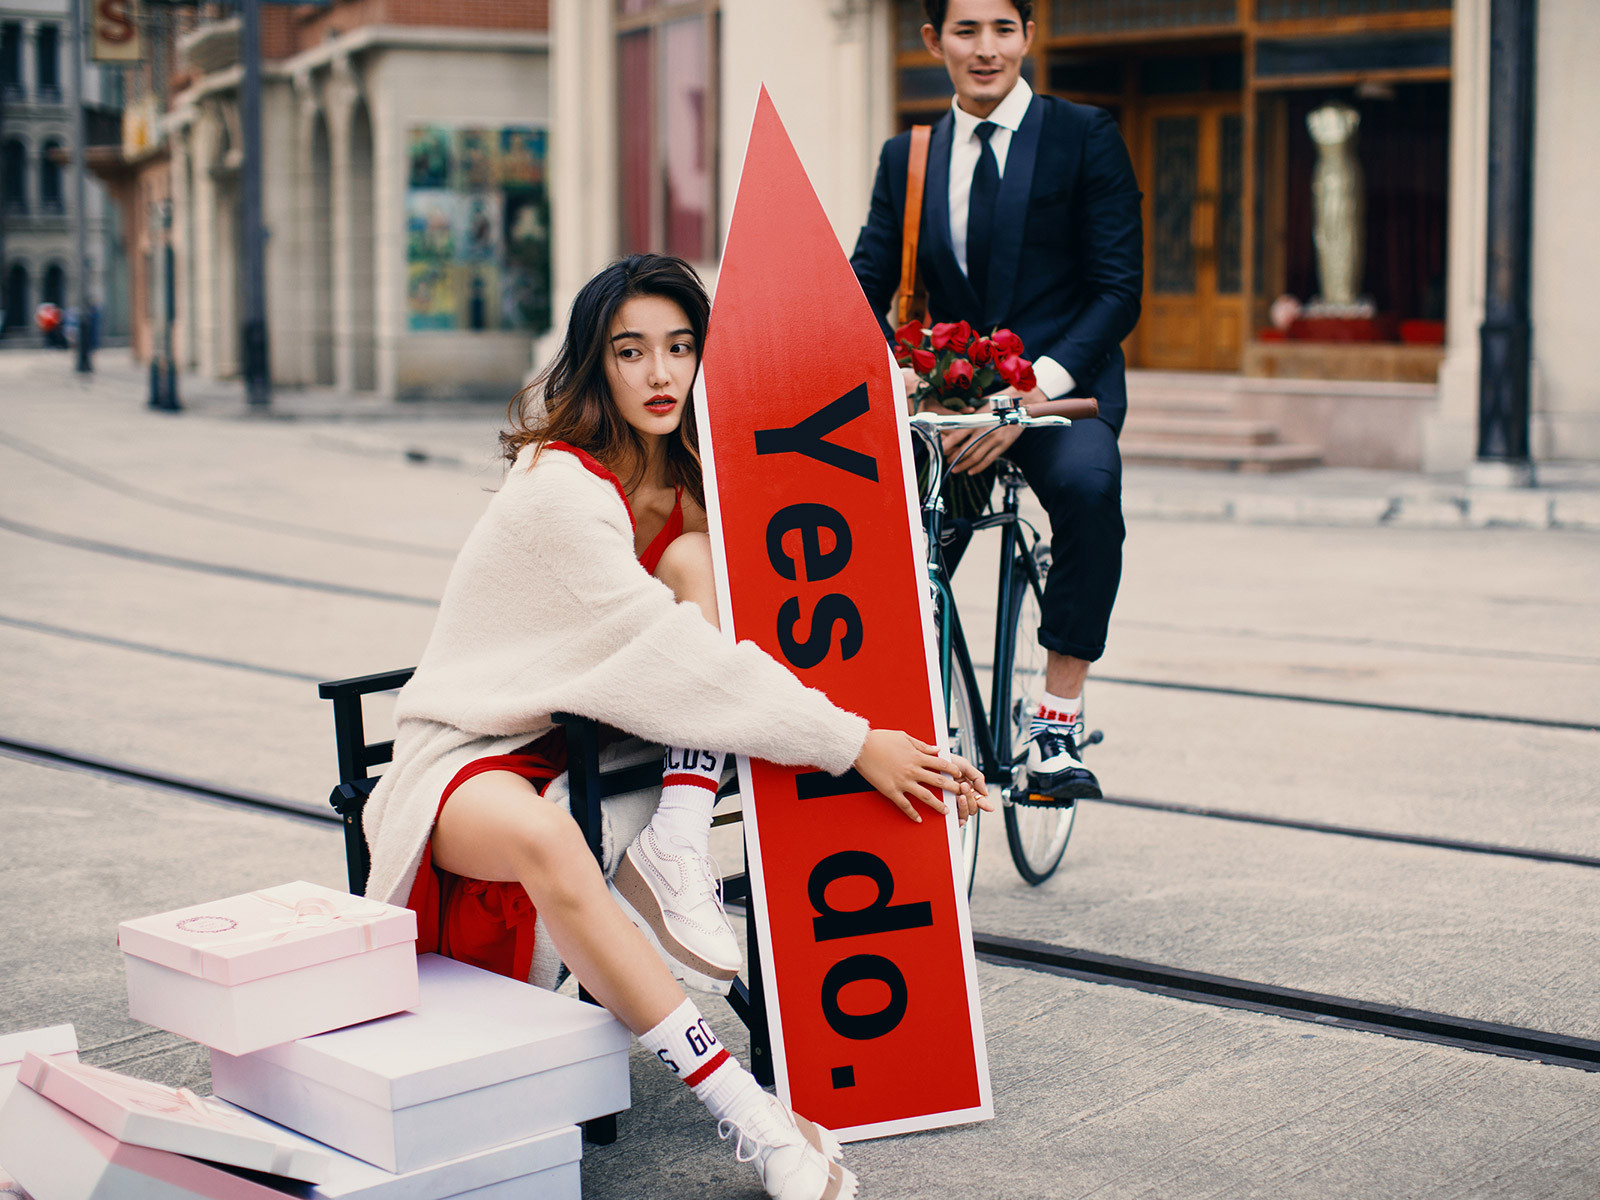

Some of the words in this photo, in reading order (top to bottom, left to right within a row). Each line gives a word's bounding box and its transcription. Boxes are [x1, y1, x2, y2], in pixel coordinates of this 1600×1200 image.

[100, 0, 133, 42] S
[754, 381, 879, 669] Yes
[663, 746, 717, 772] CDS
[807, 850, 934, 1089] do.
